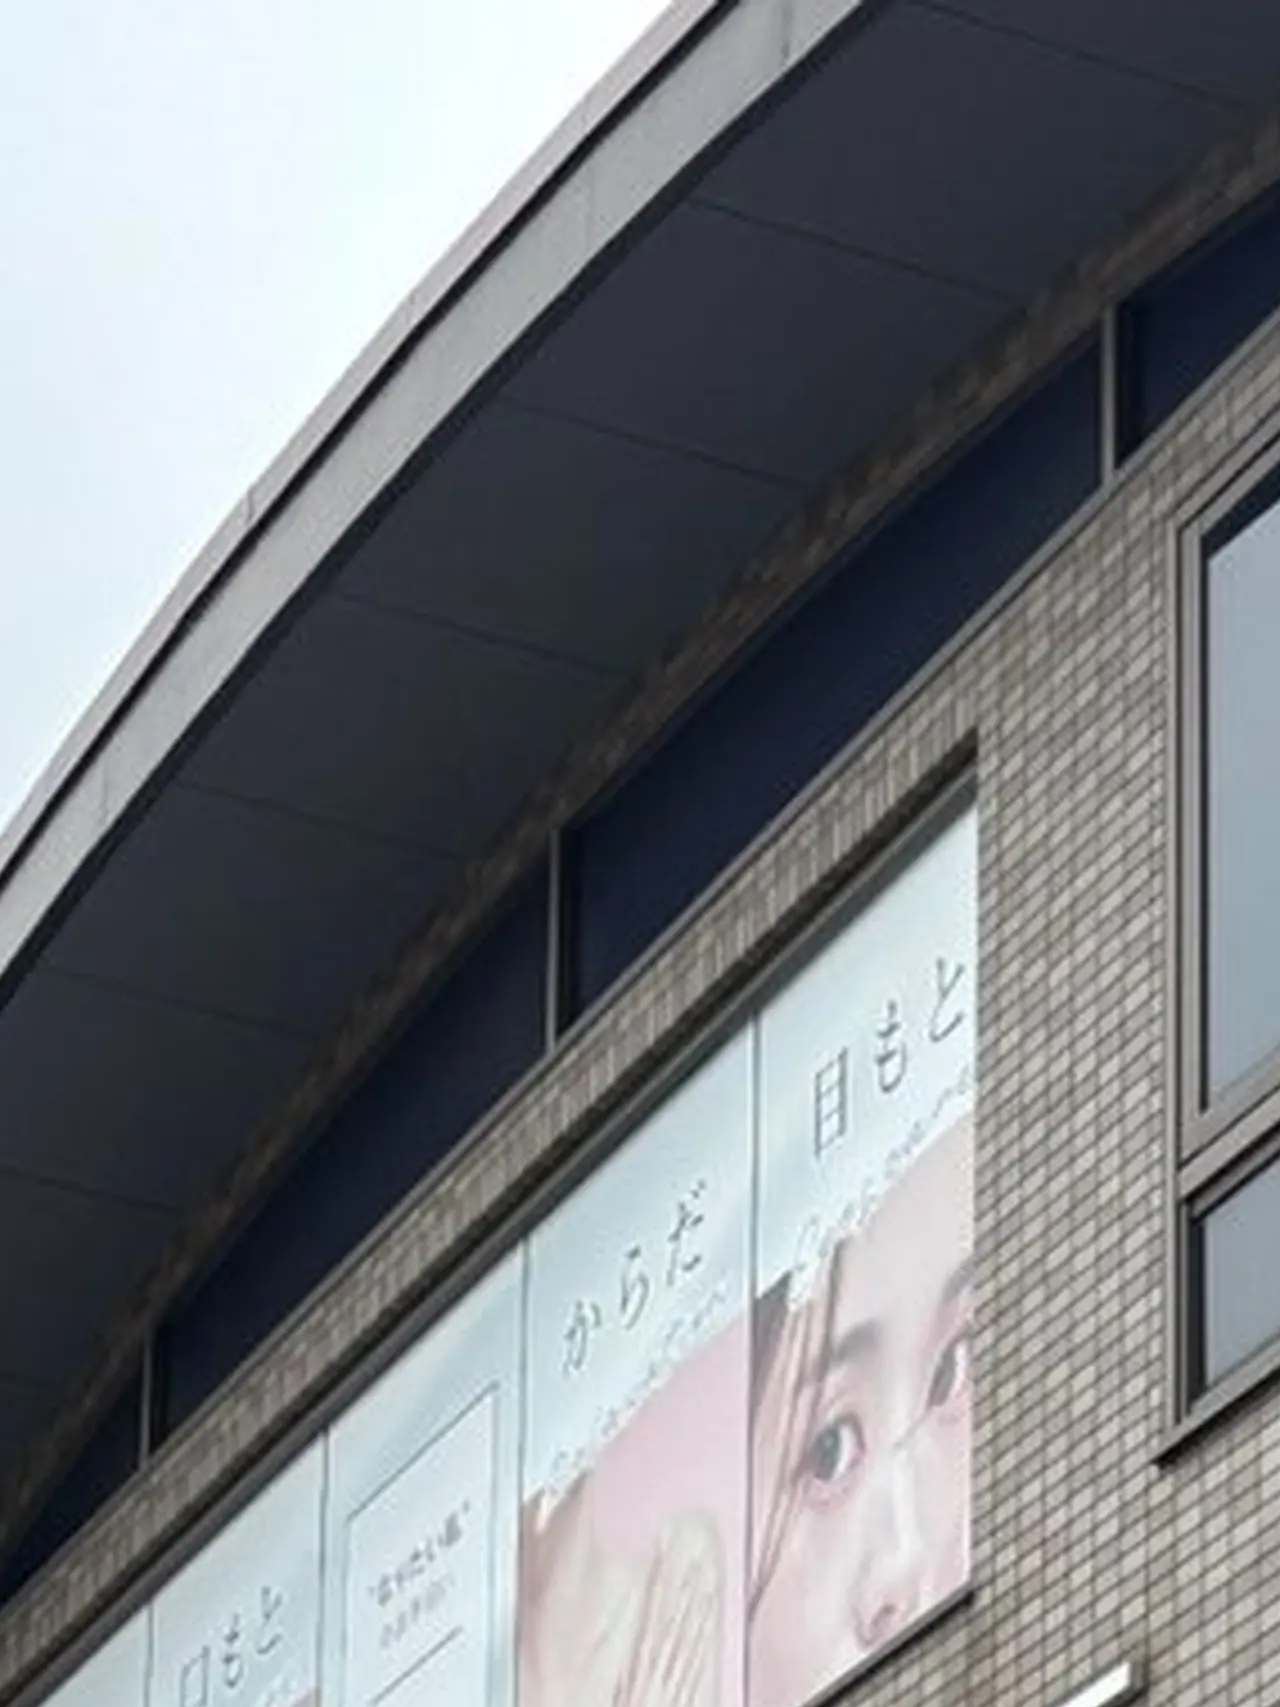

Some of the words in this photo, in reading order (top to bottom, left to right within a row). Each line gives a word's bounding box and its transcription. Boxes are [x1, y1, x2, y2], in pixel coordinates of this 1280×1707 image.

[814, 955, 966, 1162] 目もと
[562, 1180, 706, 1380] からだ
